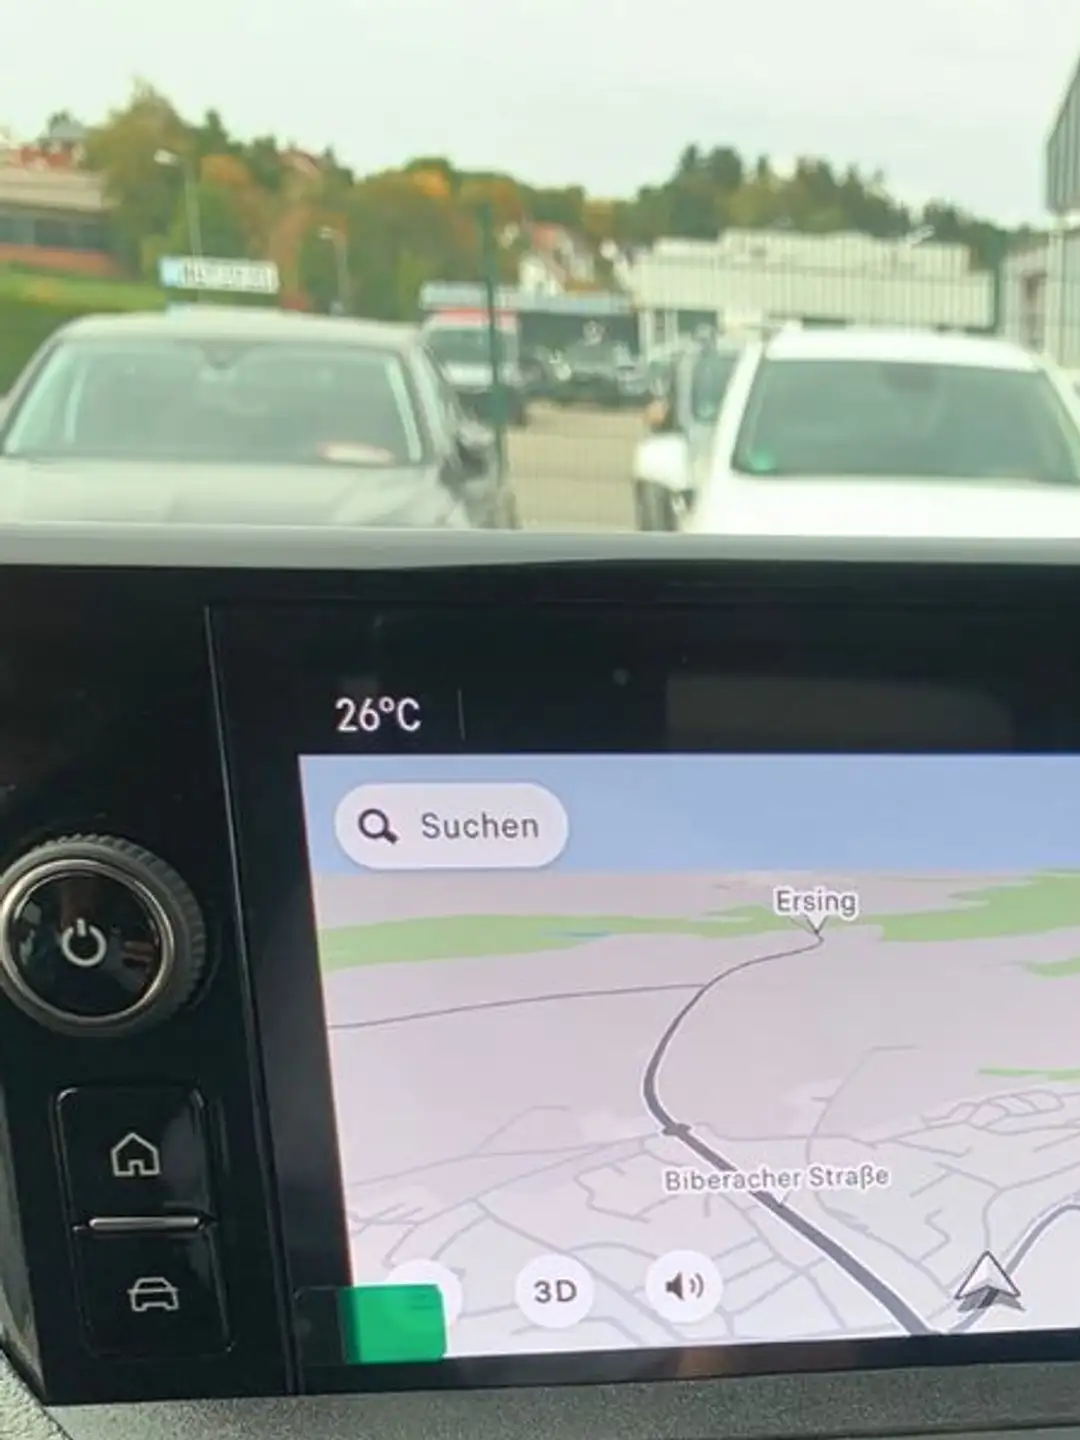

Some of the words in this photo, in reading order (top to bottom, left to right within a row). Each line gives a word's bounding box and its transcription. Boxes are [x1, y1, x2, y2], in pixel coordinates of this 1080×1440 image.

[334, 696, 422, 733] 26°C
[420, 812, 541, 840] Suchen
[776, 888, 857, 918] Ersing
[664, 1168, 802, 1193] Biberacher
[808, 1164, 890, 1189] Straße
[532, 1279, 578, 1305] 3D
